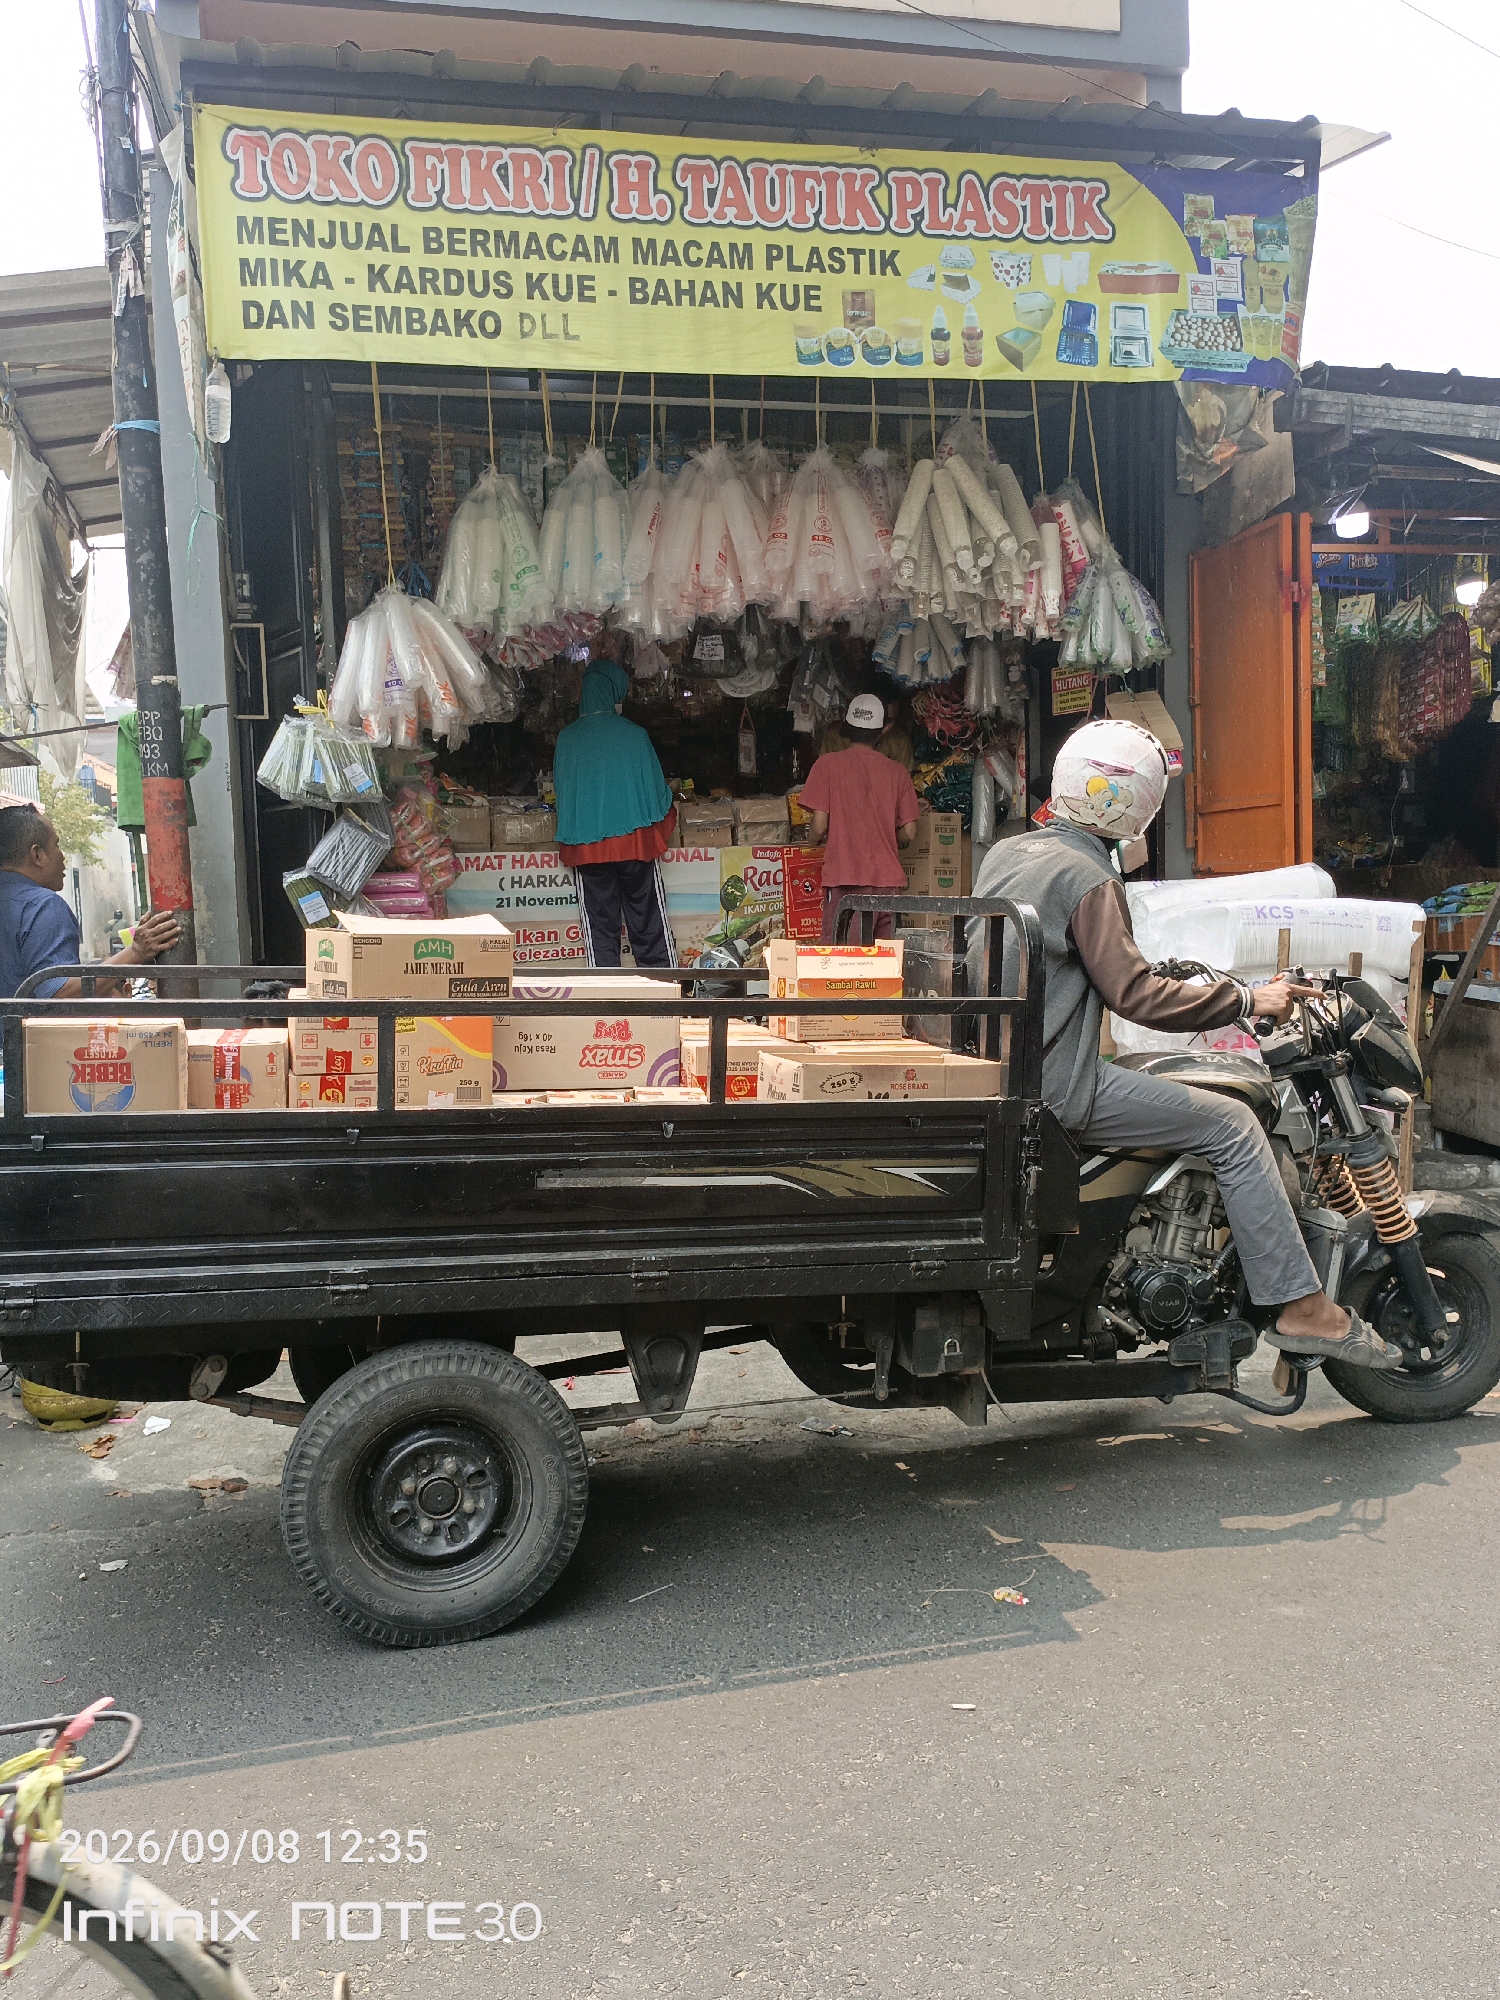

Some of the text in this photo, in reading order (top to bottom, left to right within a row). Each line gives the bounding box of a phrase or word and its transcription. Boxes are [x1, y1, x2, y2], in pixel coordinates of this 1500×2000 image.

[229, 129, 399, 206] TOKO
[406, 141, 575, 216] FIKRI
[610, 155, 672, 221] H.
[677, 159, 888, 235] TAUFIK
[888, 171, 1113, 240] PLASTIK
[237, 217, 901, 277] MENJUAL BERMACAM MACAM PLASTIK
[239, 258, 334, 291] MIKA
[367, 264, 514, 300] KARDUS
[525, 273, 596, 303] KUE
[629, 277, 743, 309] BAHAN
[756, 283, 823, 312] KUE
[242, 300, 581, 341] DAN SEMBAKO DLL
[1055, 674, 1089, 691] HUTANG
[511, 853, 559, 870] HARI
[662, 848, 715, 863] ONAL
[510, 873, 576, 889] HARKA
[743, 866, 784, 892] Rac
[496, 894, 579, 908] 21 Novemb
[744, 901, 784, 915] IKAN GOR
[1254, 905, 1295, 919] KCS
[515, 928, 559, 945] Ikan
[417, 941, 452, 955] AMH
[404, 962, 464, 974] JAHE MERAH
[451, 979, 507, 993] Gula Aren
[826, 980, 877, 990] Sambal Rawit
[518, 1032, 532, 1041] 16g
[543, 1033, 553, 1041] 40
[593, 1019, 633, 1042] Ring
[514, 1046, 533, 1054] Keju
[582, 1045, 645, 1068] Smax
[71, 1062, 134, 1085] BEBEK
[830, 1078, 847, 1089] 250
